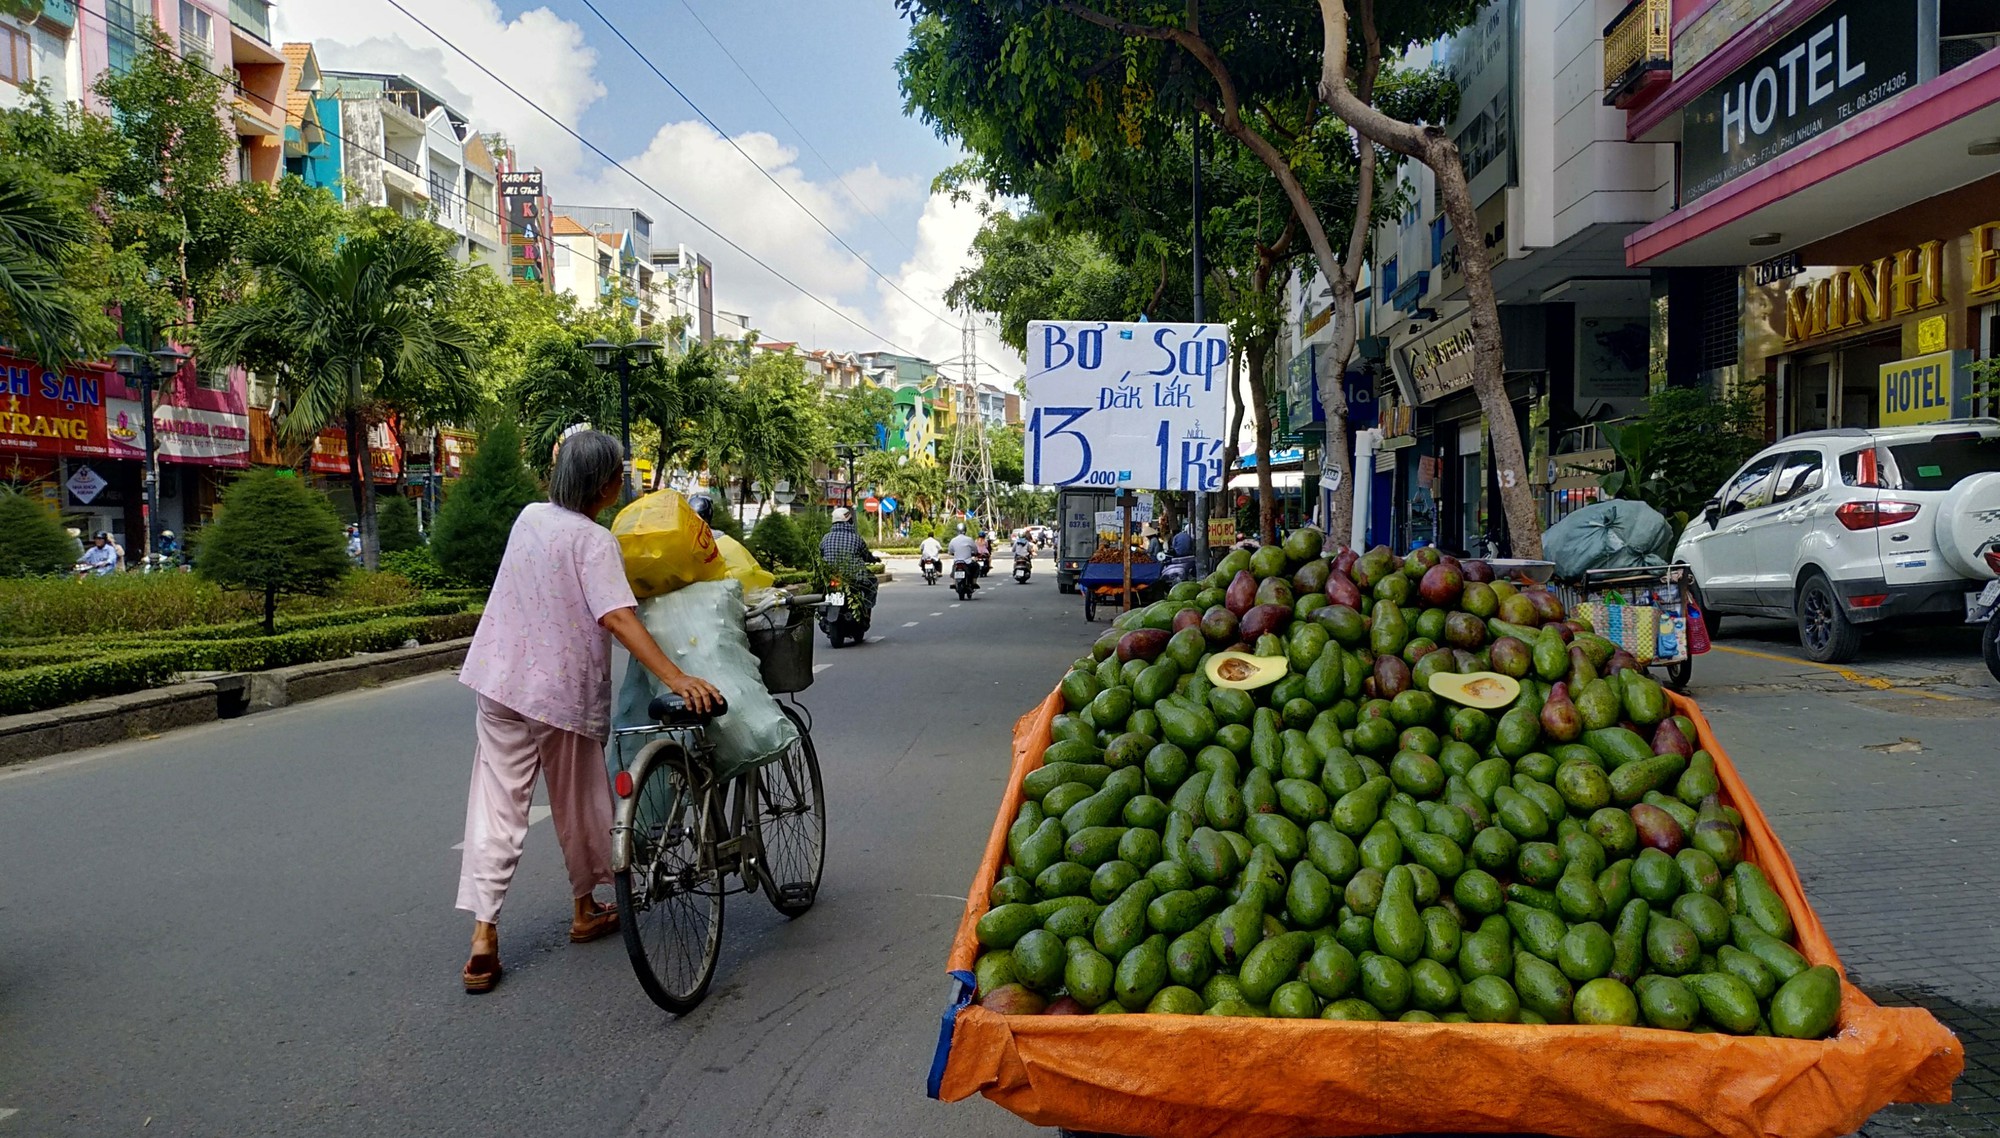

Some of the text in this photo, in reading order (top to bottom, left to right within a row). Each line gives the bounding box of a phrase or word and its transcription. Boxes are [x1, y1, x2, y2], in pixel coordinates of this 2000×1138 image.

[1722, 14, 1866, 154] HOTEL
[1837, 71, 1907, 119] TEL: 08.35174305
[1738, 153, 1757, 172] LONG
[1754, 252, 1802, 285] HOTEL
[1784, 239, 1948, 346] MINH
[40, 371, 99, 411] SẠN
[1885, 363, 1946, 414] HOTEL
